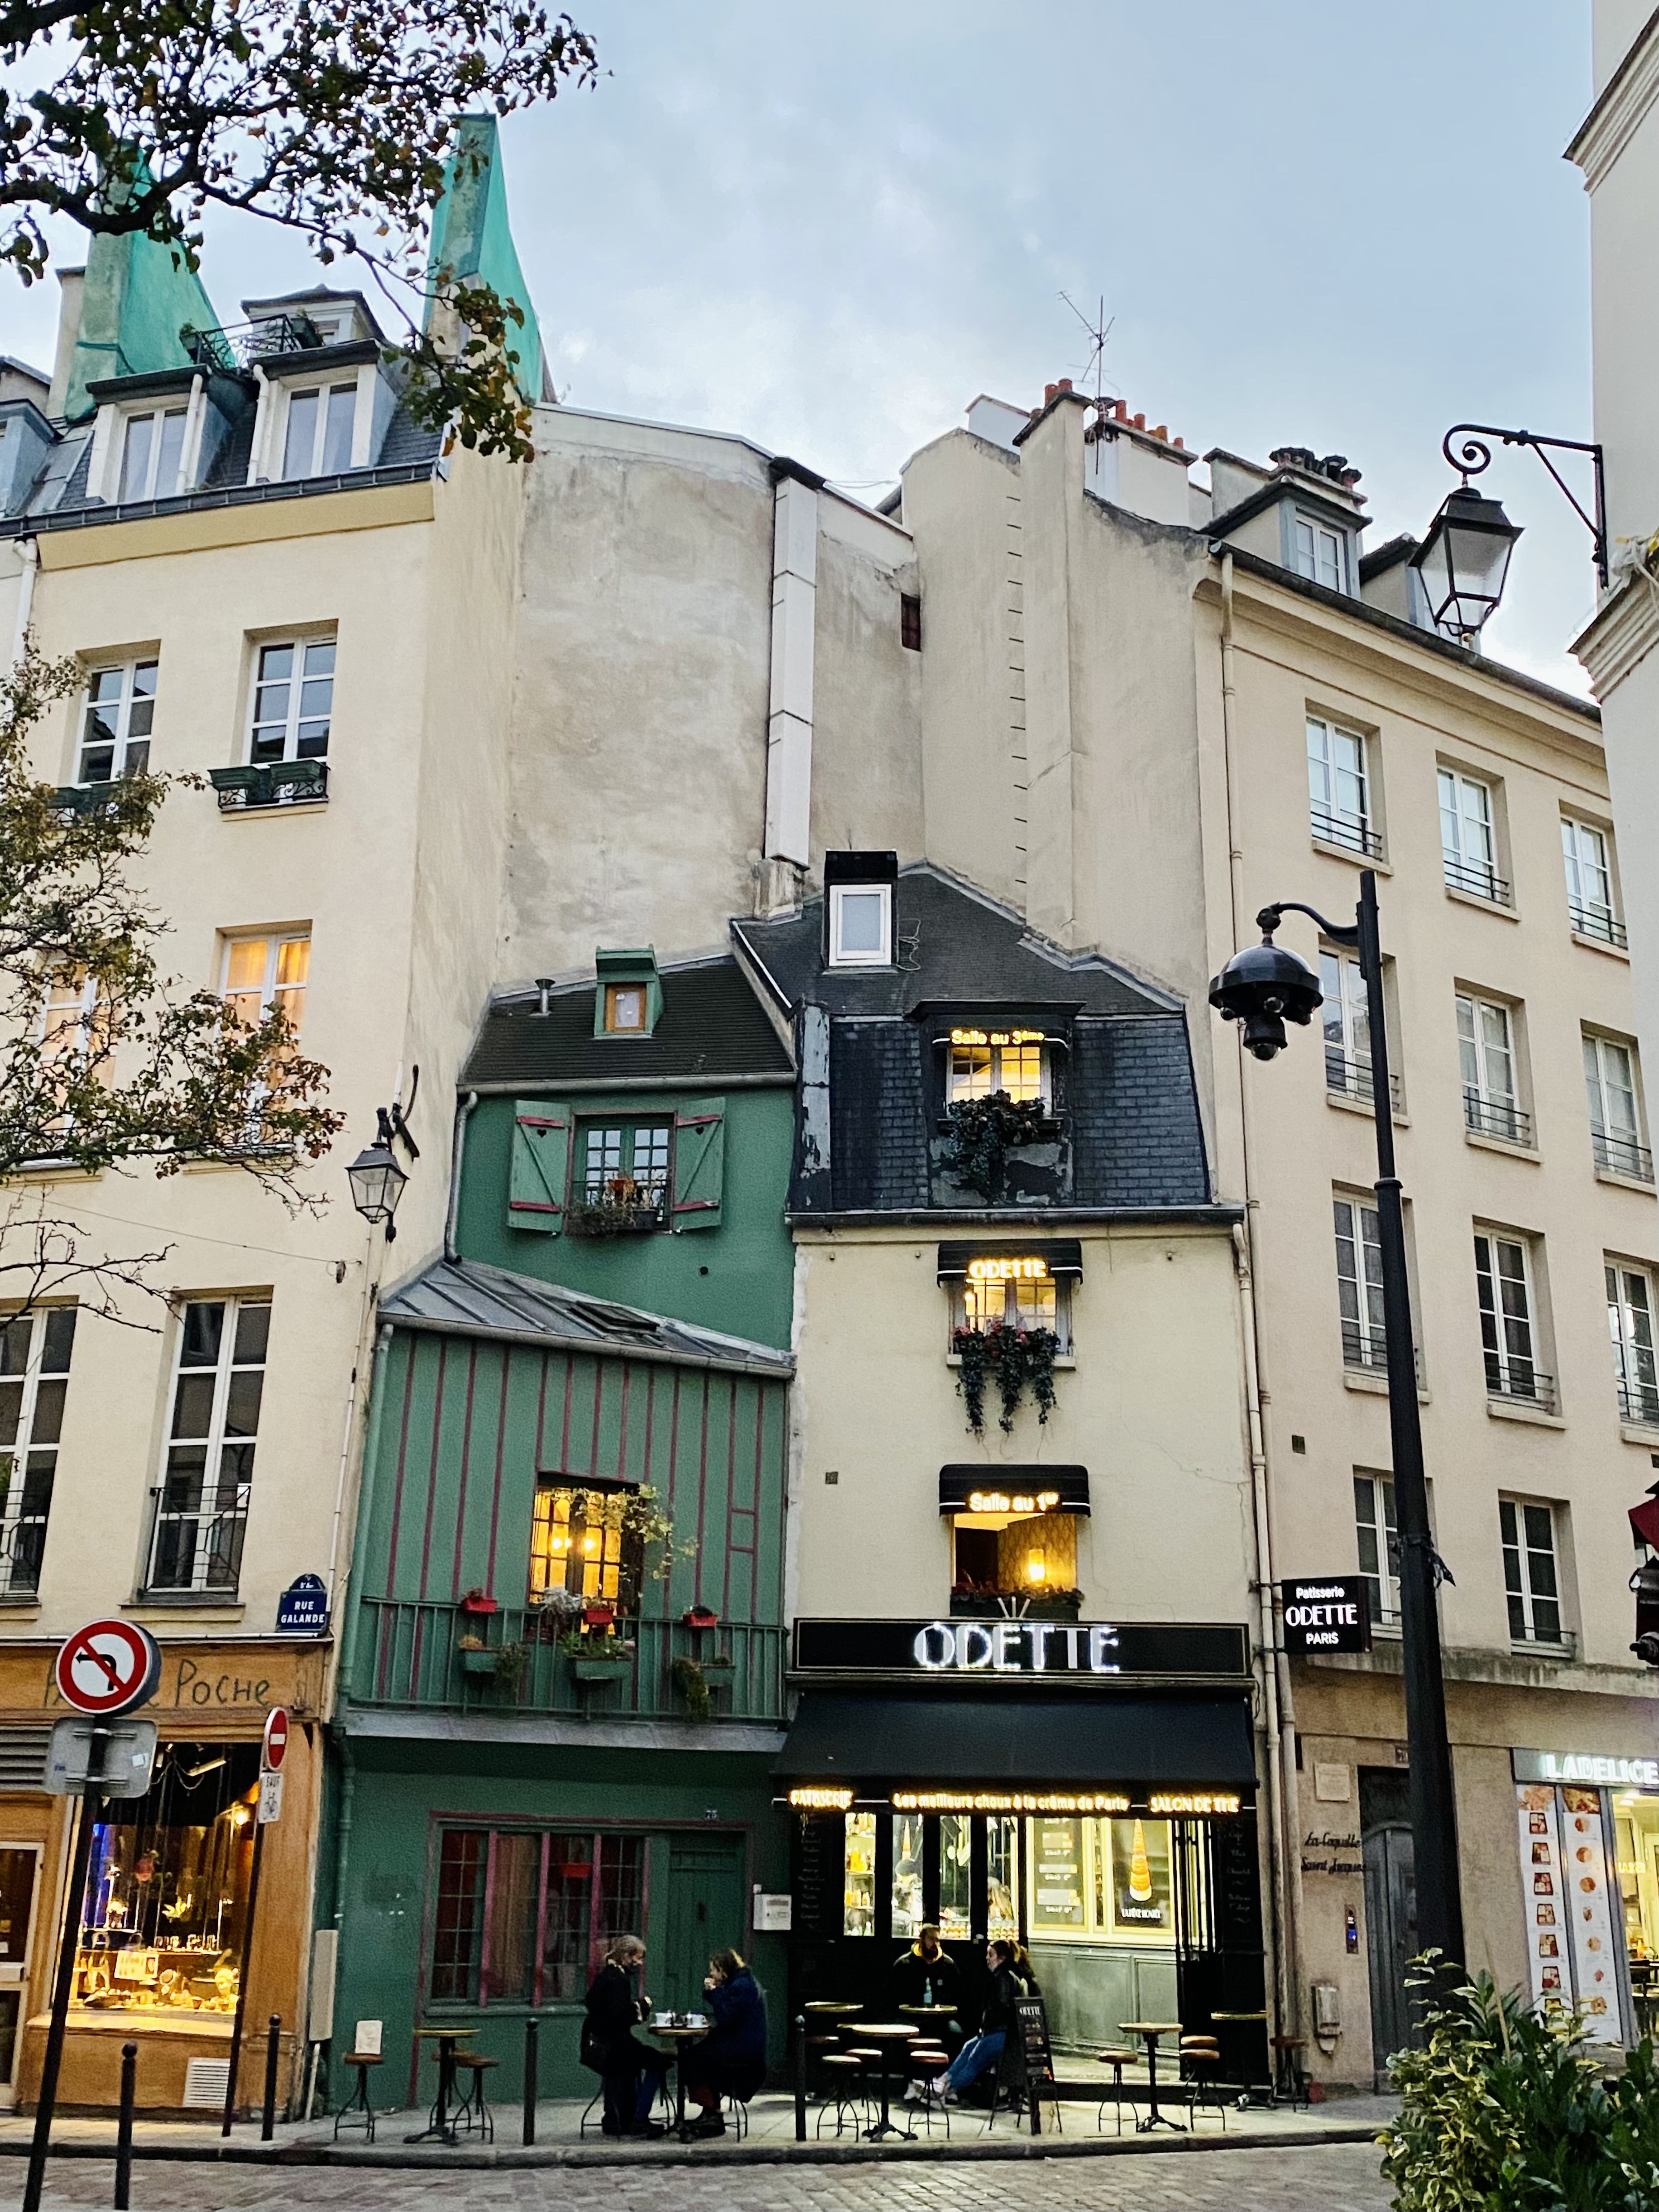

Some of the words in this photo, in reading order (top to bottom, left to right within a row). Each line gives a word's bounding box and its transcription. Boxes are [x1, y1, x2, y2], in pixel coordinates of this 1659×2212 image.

[952, 1030, 987, 1044] Salle
[990, 1033, 1009, 1045] au
[969, 1259, 1047, 1279] ODETTE
[970, 1492, 1010, 1512] Salle
[1013, 1496, 1034, 1512] au
[1296, 1586, 1345, 1599] Patisserie
[294, 1601, 314, 1610] RUE
[281, 1614, 325, 1623] GALANDE
[1285, 1604, 1358, 1626] ODETTE
[1306, 1632, 1339, 1645] PARIS
[914, 1623, 1120, 1672] ODETTE
[894, 1793, 917, 1808] Les
[918, 1793, 974, 1808] meilleurs
[975, 1794, 1011, 1808] choux
[1023, 1796, 1036, 1810] la
[1077, 1796, 1093, 1810] de
[1095, 1796, 1129, 1811] Paris
[1150, 1797, 1192, 1812] SALON
[1194, 1797, 1211, 1812] DE
